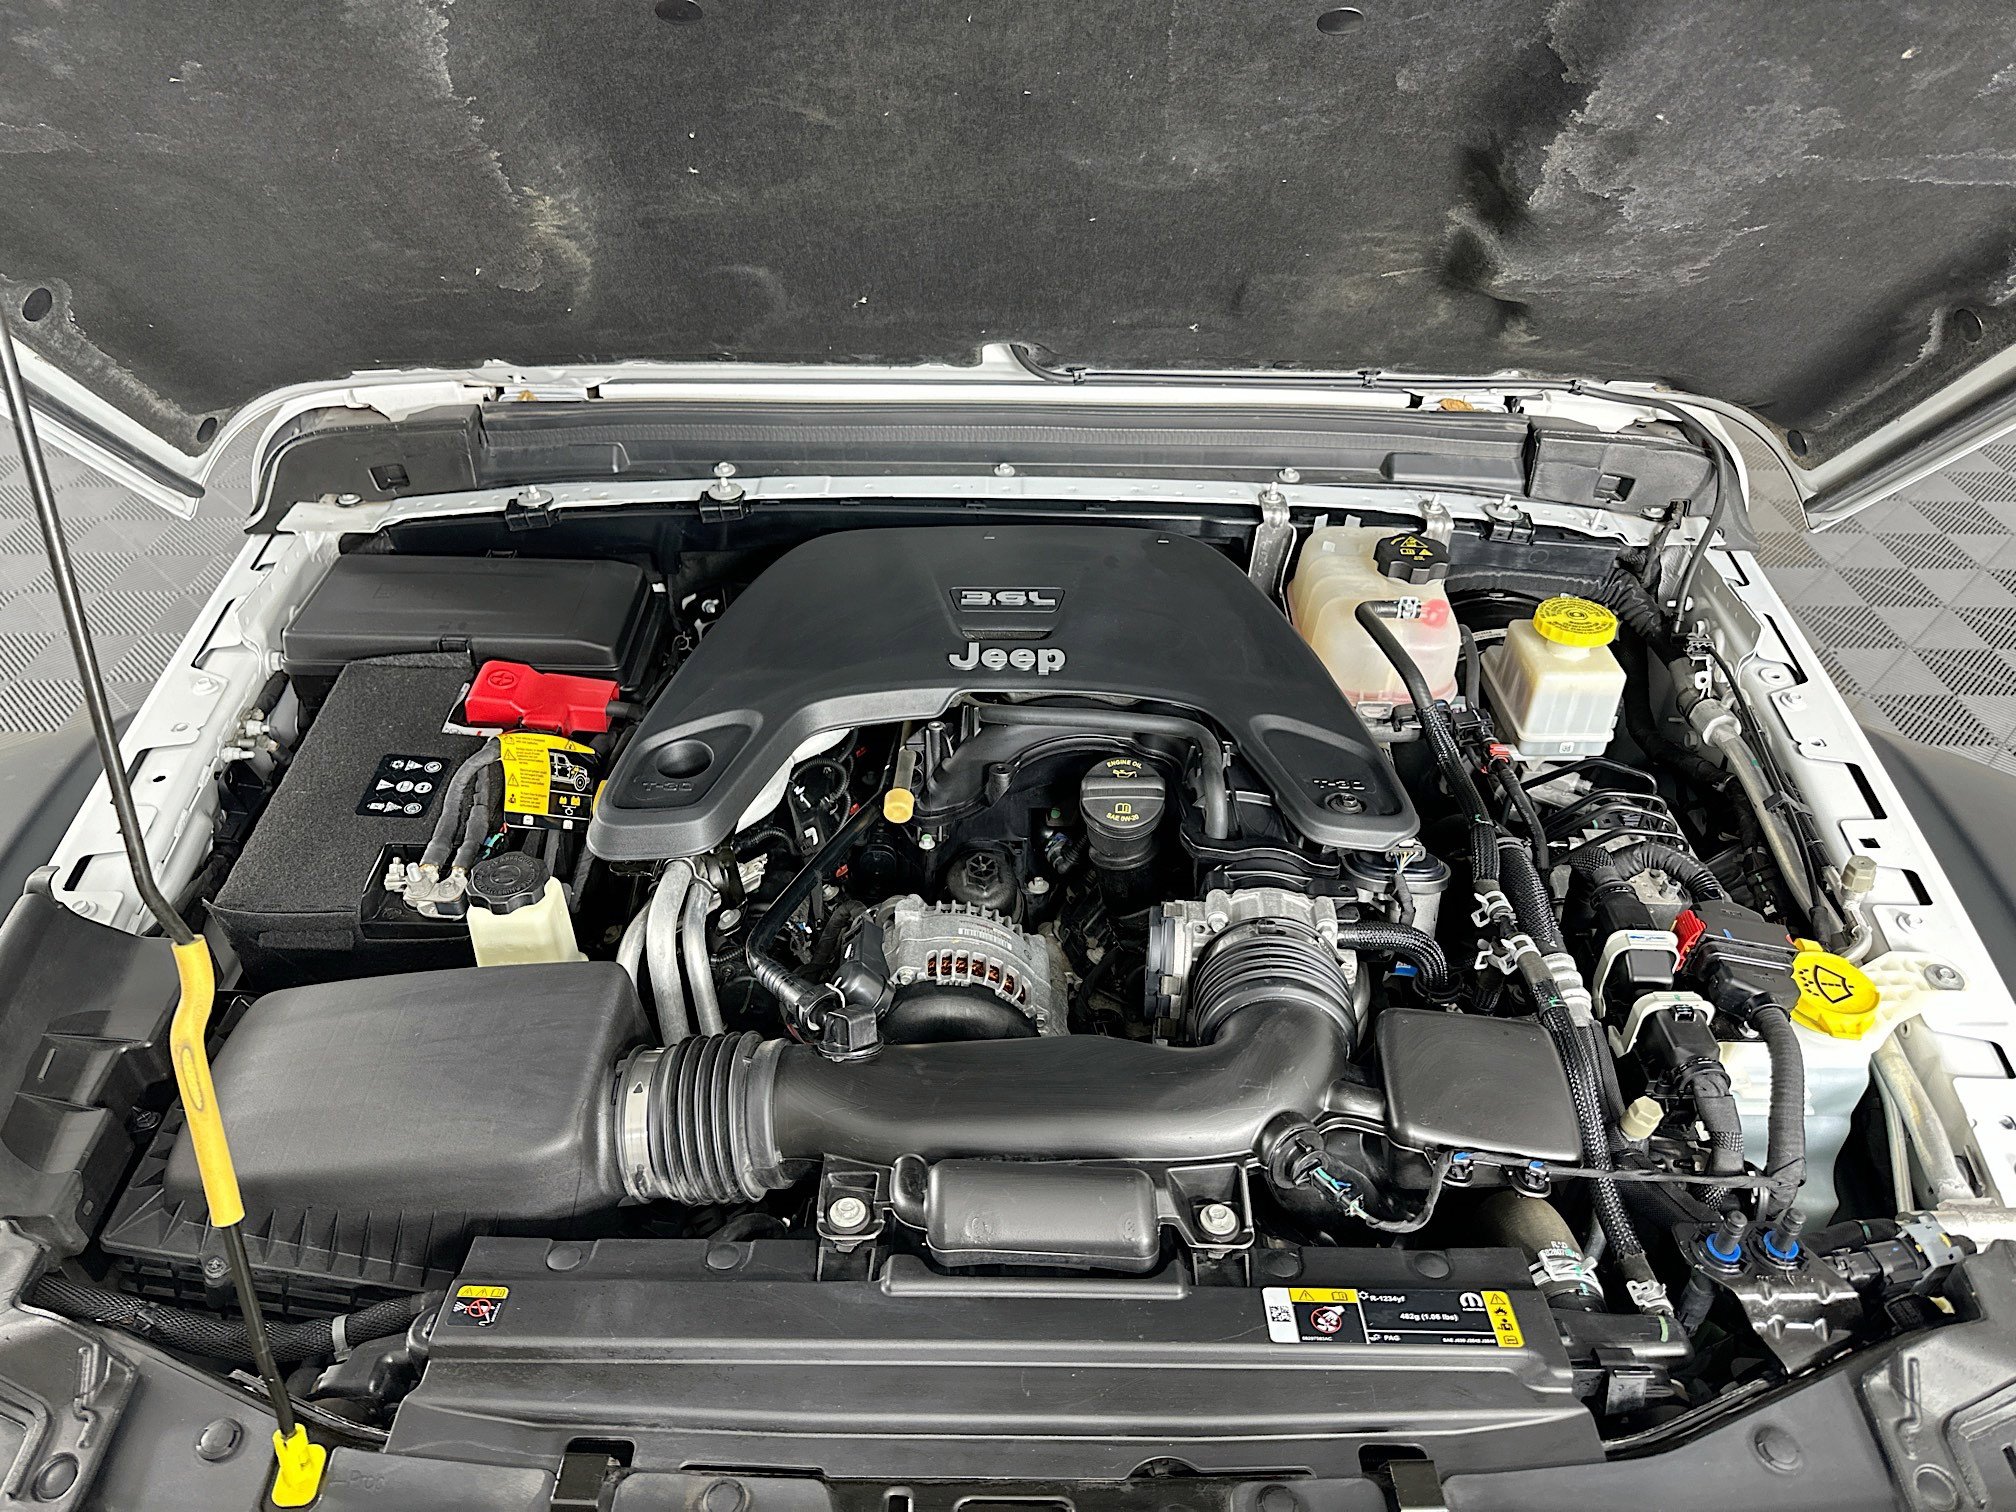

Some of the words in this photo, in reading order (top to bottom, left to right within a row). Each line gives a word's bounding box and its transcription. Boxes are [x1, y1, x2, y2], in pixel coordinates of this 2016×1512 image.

[960, 591, 1056, 606] 3.6L
[948, 642, 1066, 676] Jeep
[1106, 759, 1131, 768] ENGINE
[1132, 760, 1142, 769] OIL
[1106, 812, 1119, 821] SAE
[1120, 813, 1140, 822] 0W-20
[1369, 1294, 1406, 1304] R-1234yf
[1400, 1313, 1420, 1321] 482g
[1384, 1334, 1401, 1342] PAG
